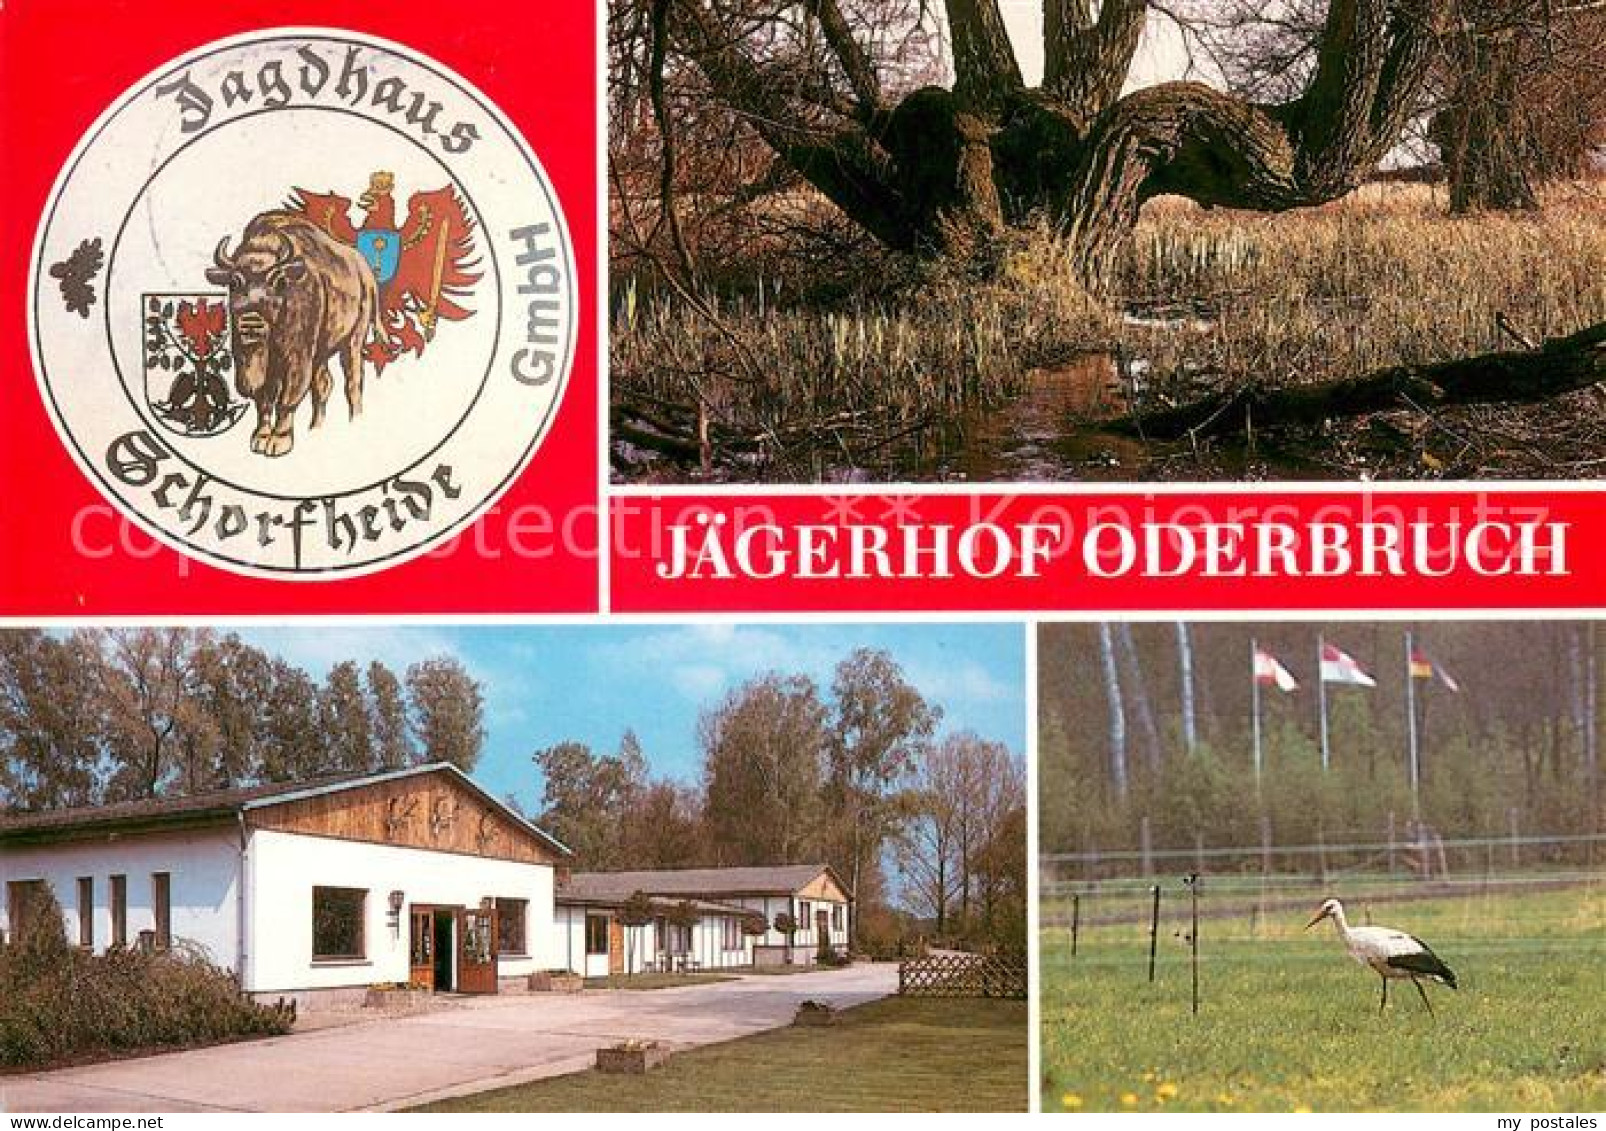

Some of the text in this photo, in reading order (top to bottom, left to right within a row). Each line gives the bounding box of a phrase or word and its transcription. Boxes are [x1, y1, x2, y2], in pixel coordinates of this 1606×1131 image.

[156, 44, 481, 154] Jagdhaus
[510, 222, 562, 387] GmbH
[106, 430, 462, 571] Schorfheide
[656, 512, 1572, 579] JÄGERHOF ODERBRUCH
